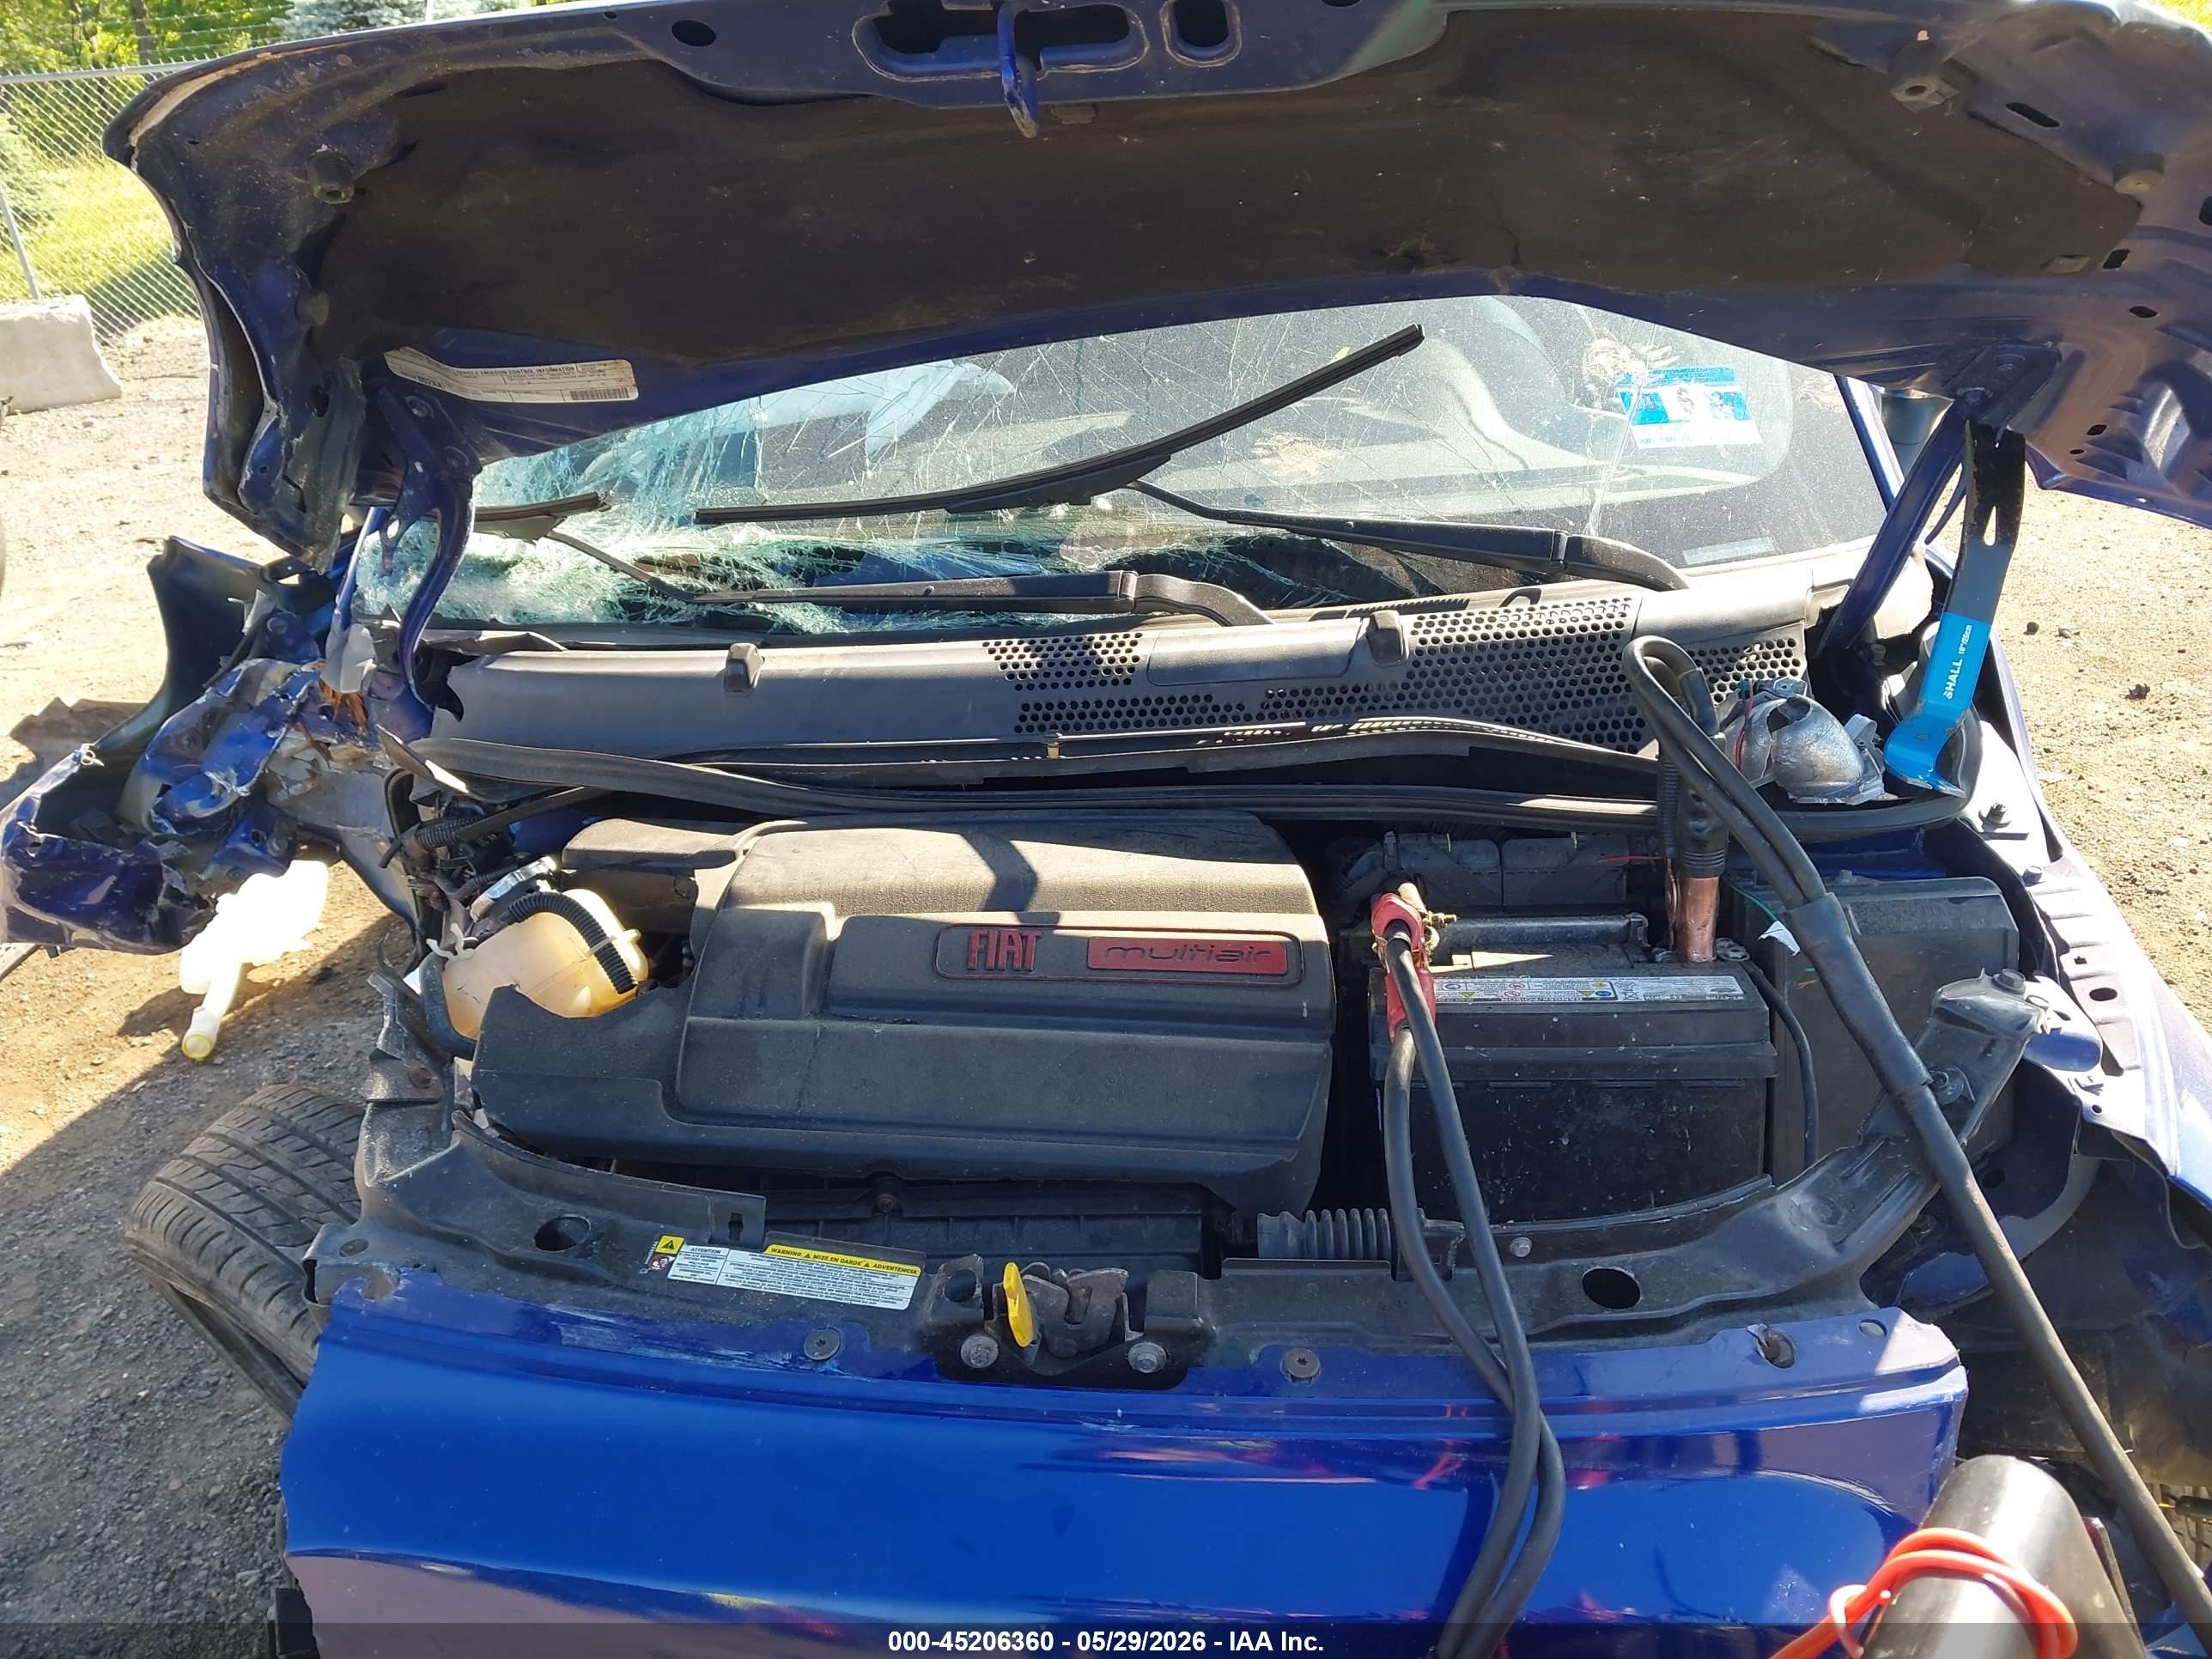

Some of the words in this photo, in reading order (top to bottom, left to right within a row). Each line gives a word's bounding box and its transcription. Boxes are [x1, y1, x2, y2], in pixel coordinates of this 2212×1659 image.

[1942, 659, 1964, 700] SHALL
[967, 928, 1044, 971] FIAT
[1104, 941, 1272, 963] multiair
[770, 1248, 802, 1257] WARNING
[840, 1258, 862, 1267] GARDE
[872, 1263, 918, 1274] ADVERTENCIA
